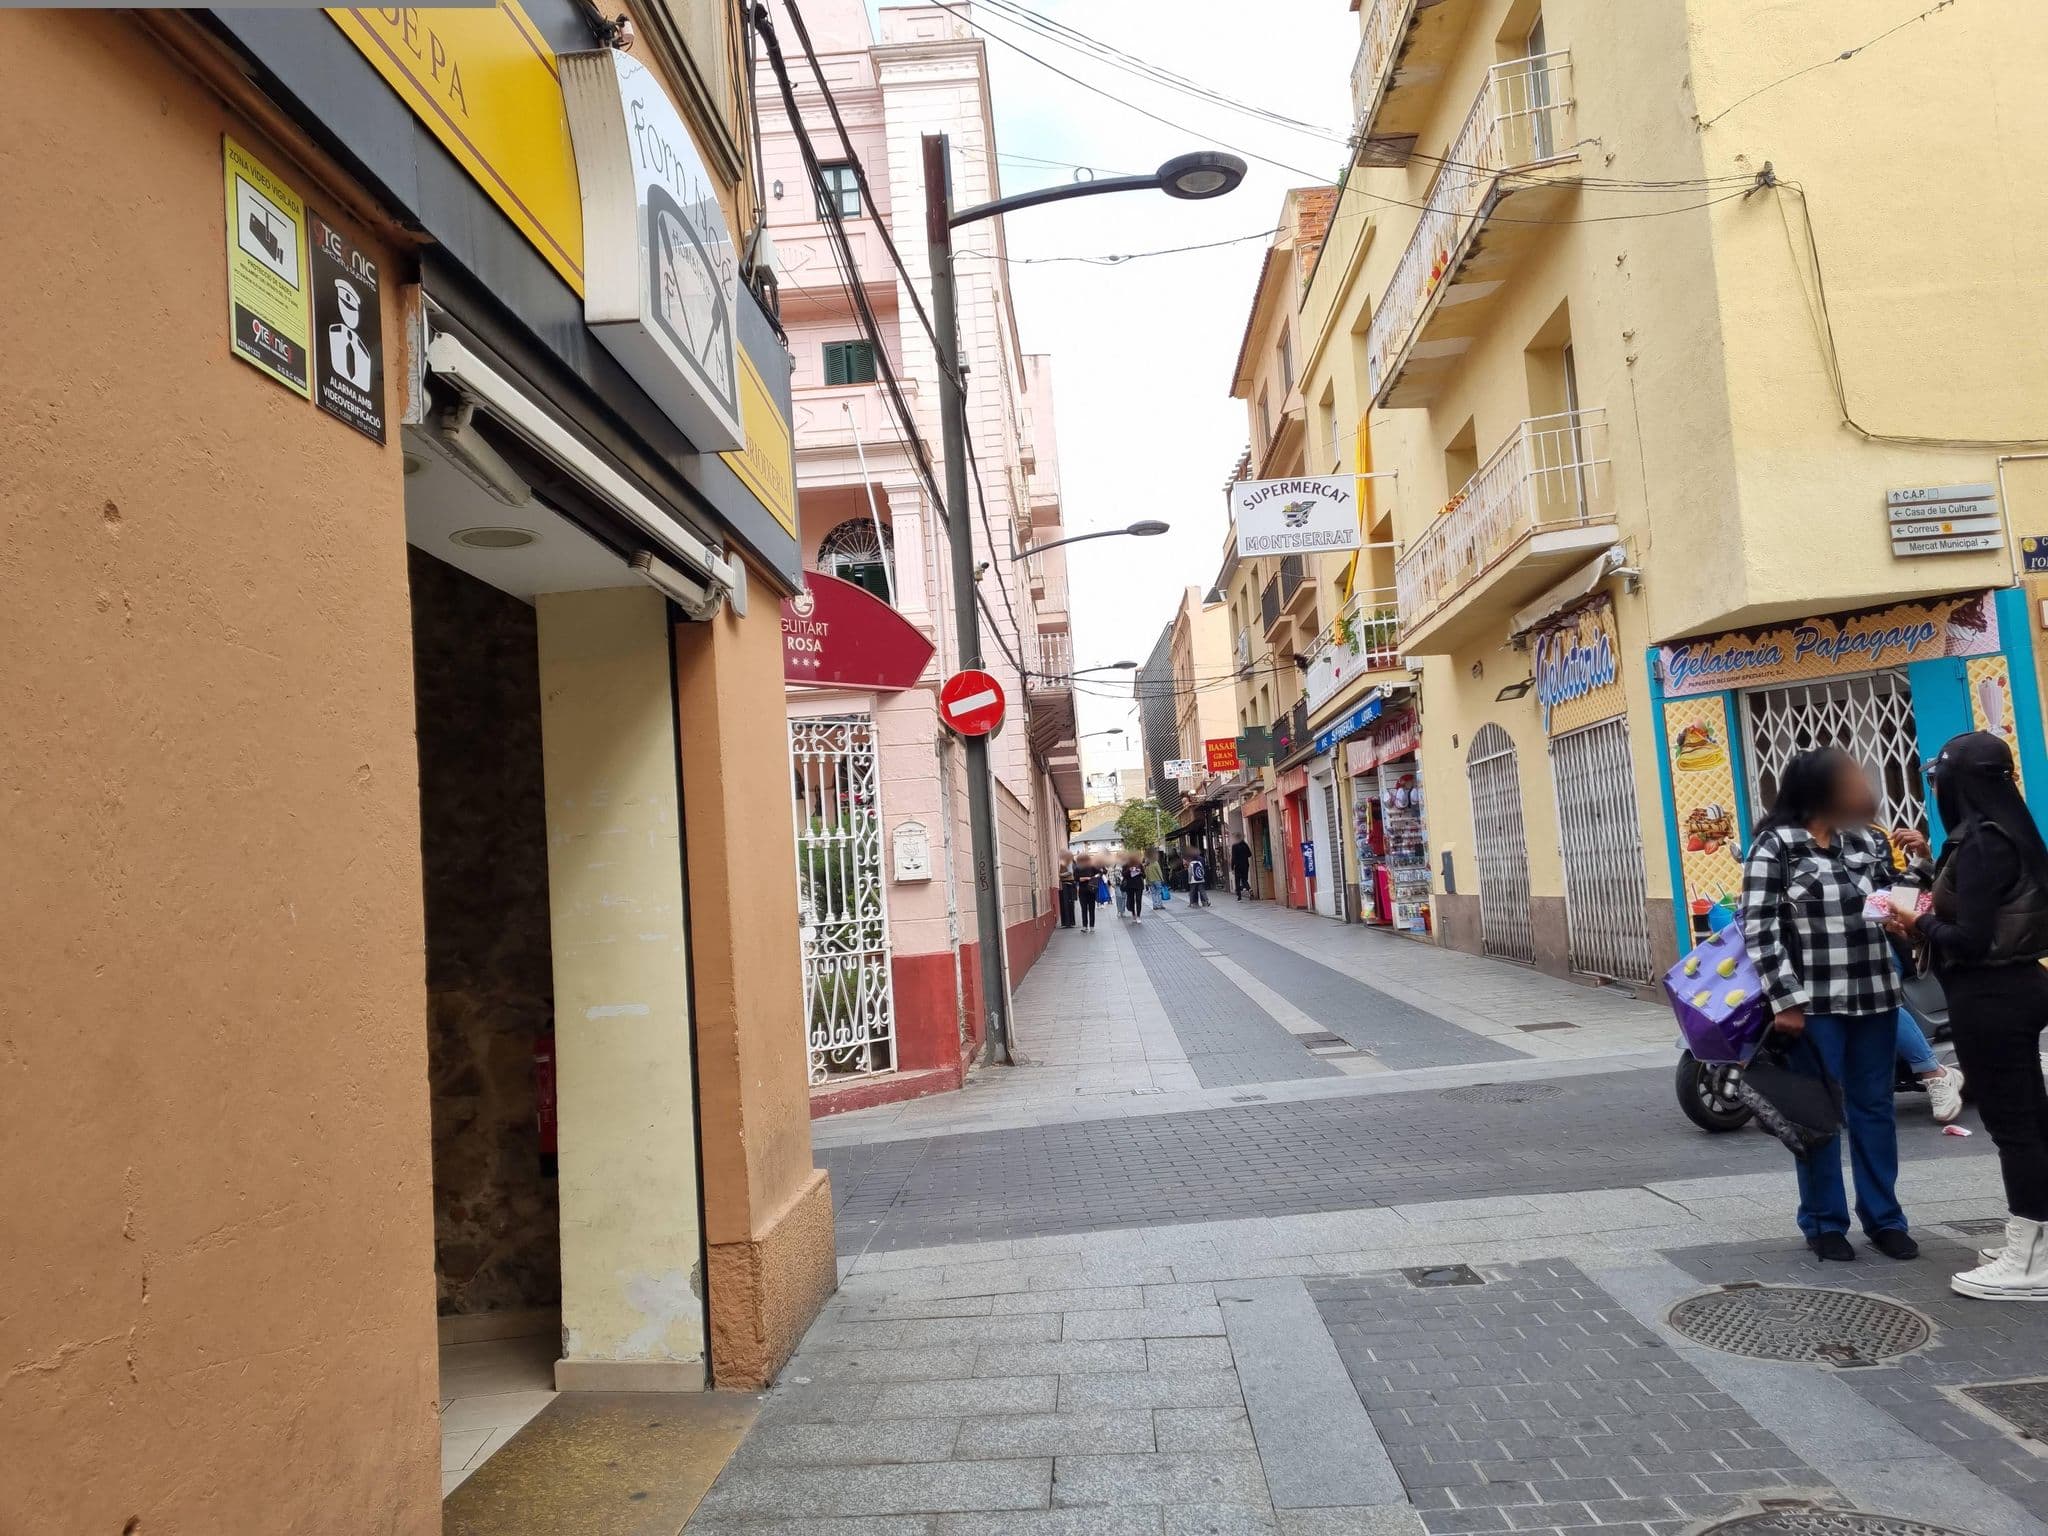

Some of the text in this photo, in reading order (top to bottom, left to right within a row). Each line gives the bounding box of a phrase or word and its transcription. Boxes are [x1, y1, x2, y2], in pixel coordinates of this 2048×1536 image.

[228, 147, 249, 171] ZONA
[272, 184, 300, 214] VIGILADA
[329, 375, 358, 401] ALARMA
[357, 393, 373, 410] AMB
[322, 384, 381, 429] VIDEOVERIFICACIÓ
[1242, 481, 1351, 511] SUPERMERCAT
[1902, 489, 1926, 500] C.A.P.
[1904, 503, 1978, 517] Casa de la Cultura
[1907, 523, 1940, 534] Correus
[1245, 528, 1354, 551] MONTSERRAT
[1909, 537, 1979, 551] Mercat Municipal
[780, 617, 829, 636] GUITART
[787, 636, 823, 653] ROSA
[1669, 620, 1937, 690] Gelateria Papagayo
[1535, 625, 1616, 735] Gelateria
[1208, 741, 1236, 752] BASAR
[1213, 751, 1233, 760] GRAN
[1213, 759, 1235, 768] REINO
